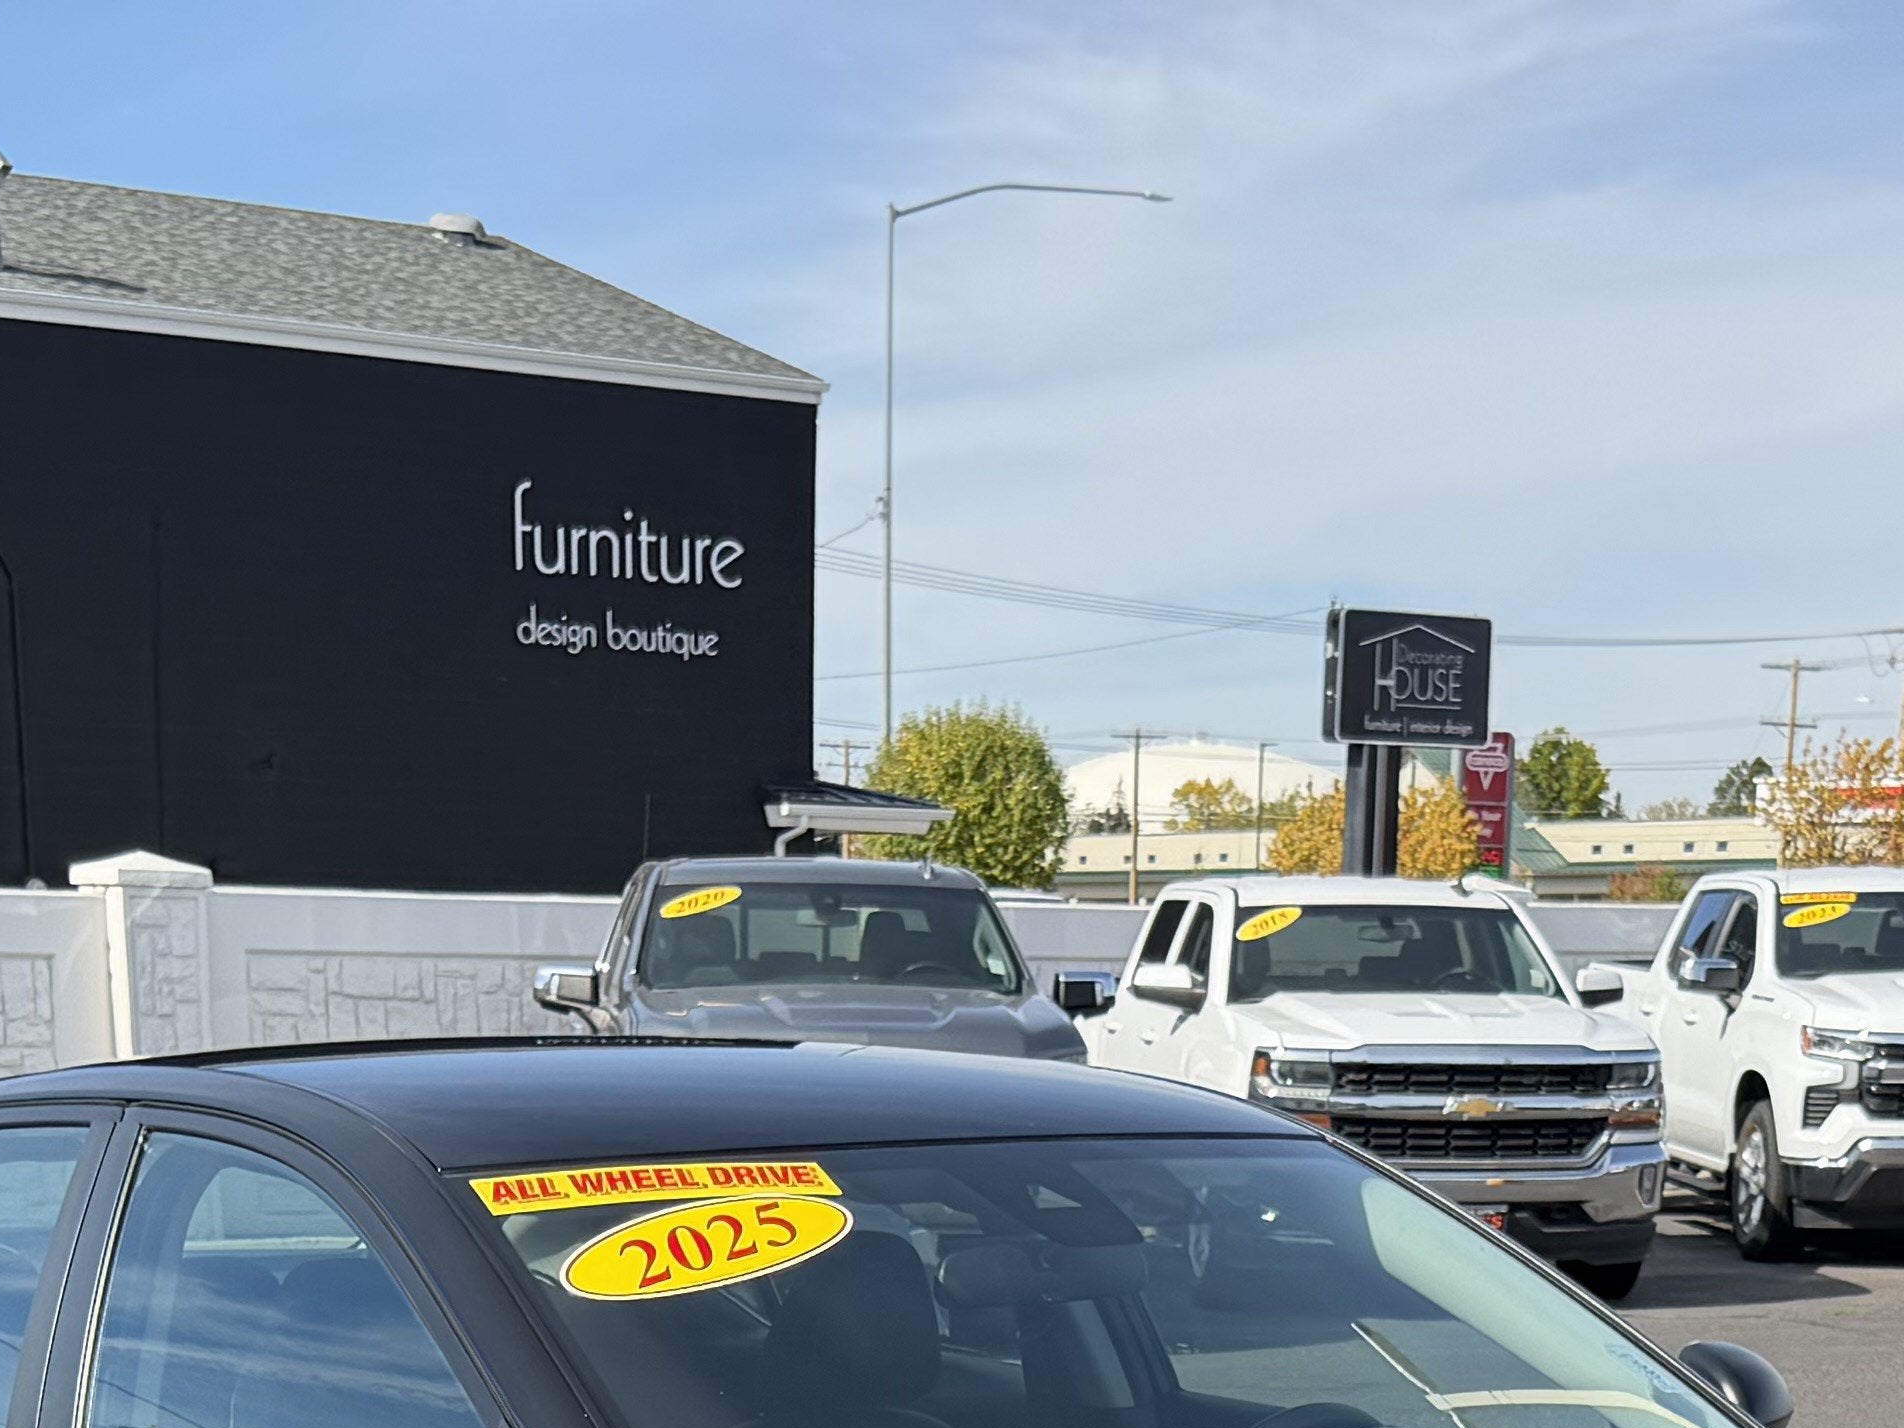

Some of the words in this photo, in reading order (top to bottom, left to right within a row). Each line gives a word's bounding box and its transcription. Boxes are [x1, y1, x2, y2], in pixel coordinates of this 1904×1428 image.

[514, 478, 745, 589] furniture
[516, 601, 598, 655] design
[606, 605, 720, 662] boutique
[1373, 637, 1463, 713] HOUSE
[675, 890, 725, 914] 2020
[491, 1179, 568, 1205] ALL
[567, 1167, 706, 1196] WHEEL
[707, 1164, 824, 1188] DRIVE
[618, 1200, 798, 1290] 2025
